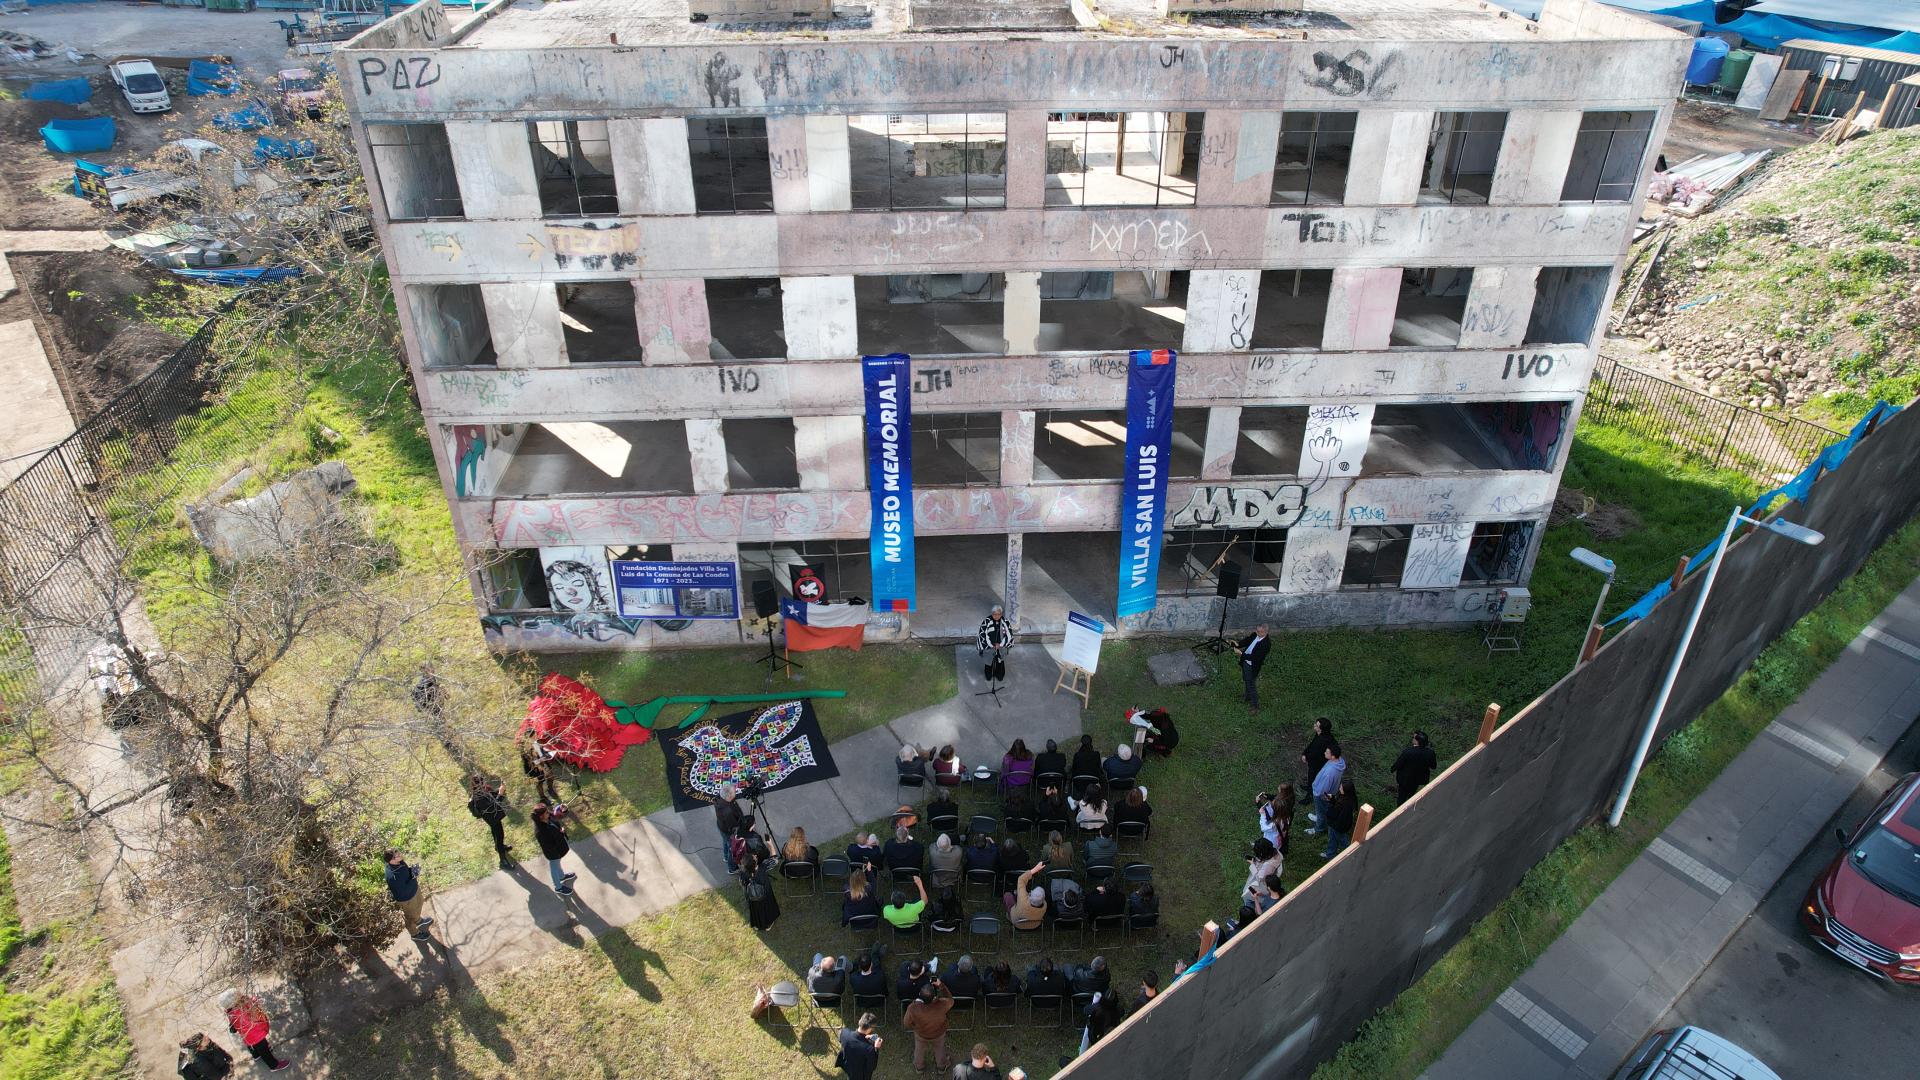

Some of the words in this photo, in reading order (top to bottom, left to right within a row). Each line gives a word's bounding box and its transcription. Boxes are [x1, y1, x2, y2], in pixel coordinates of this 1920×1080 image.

[1160, 45, 1185, 68] JH
[358, 57, 441, 95] PAZ
[718, 368, 760, 394] IVO
[914, 369, 953, 393] JH
[1502, 353, 1554, 380] IVO
[878, 373, 899, 491] MEMORIAL
[1137, 444, 1158, 490] LUIS
[1135, 494, 1154, 533] SAN
[1172, 484, 1309, 529] MDC
[882, 495, 902, 563] MUSEO
[658, 565, 698, 573] Desalojados
[1131, 535, 1151, 588] VILLA
